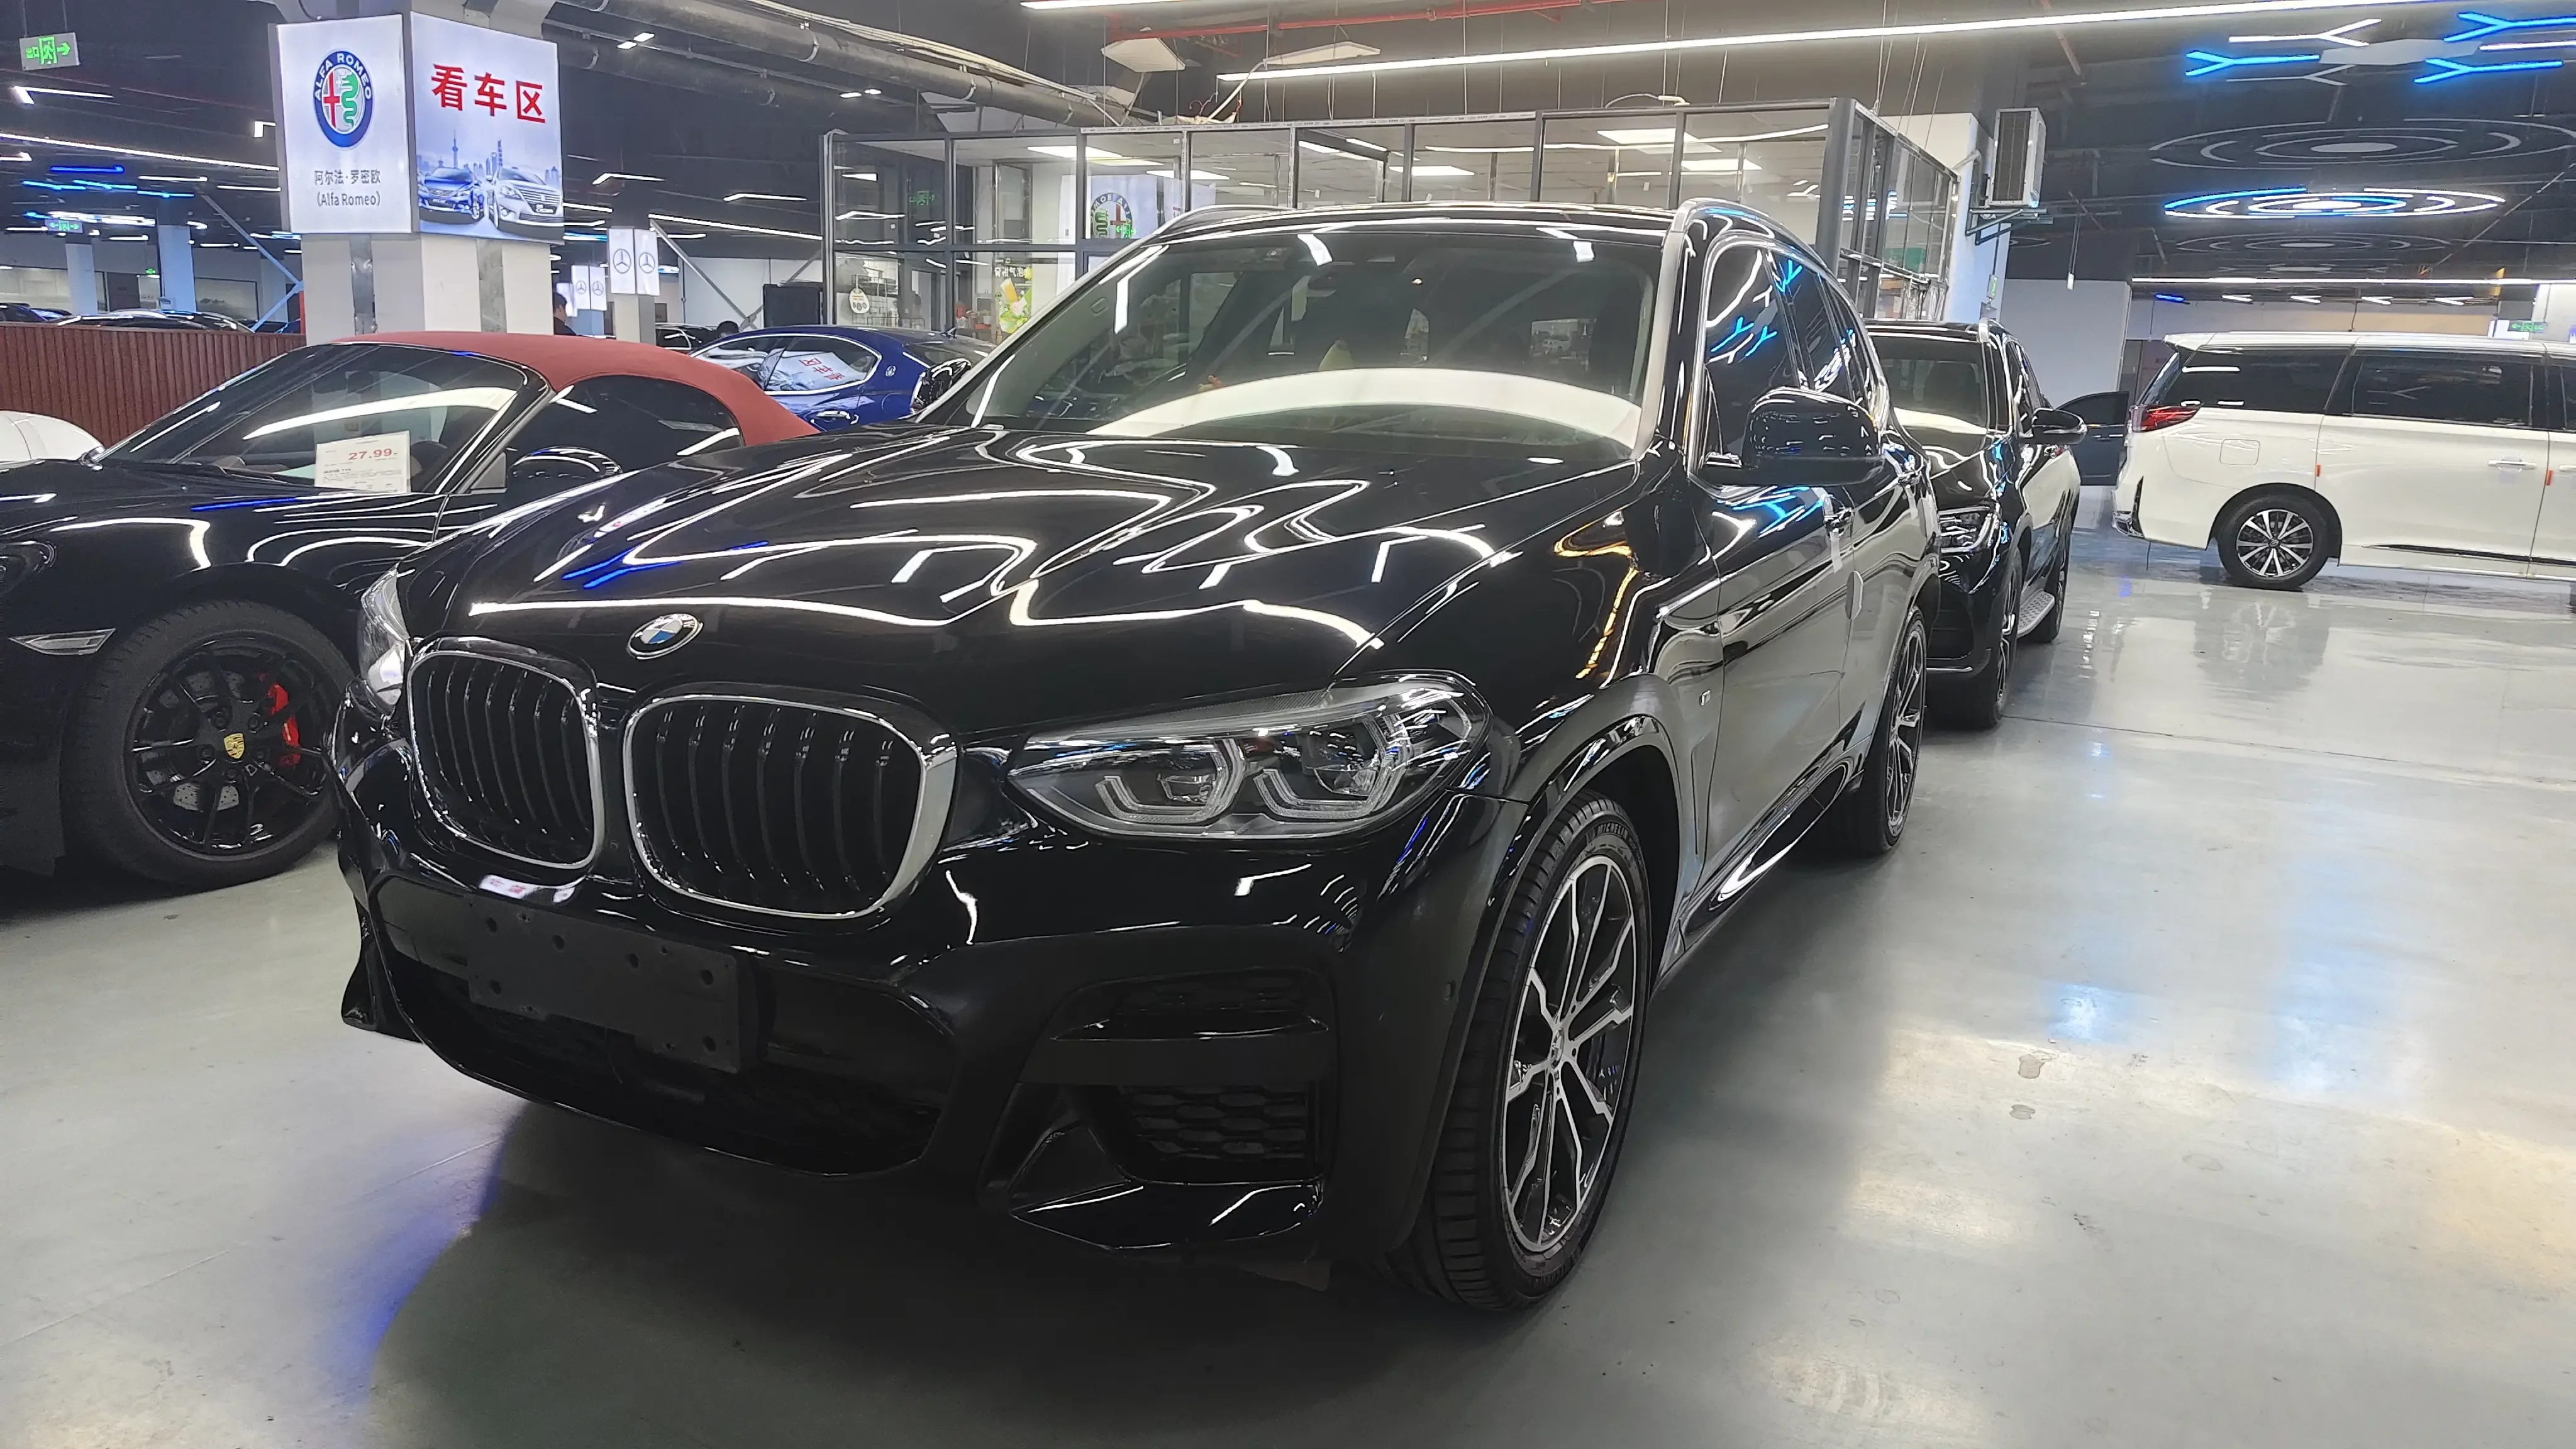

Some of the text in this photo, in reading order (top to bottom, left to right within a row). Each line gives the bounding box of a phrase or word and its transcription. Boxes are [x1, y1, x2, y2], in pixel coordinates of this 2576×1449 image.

[314, 52, 372, 101] ALFA ROMEO
[431, 64, 545, 124] 看车区
[314, 169, 380, 185] 阿尔法·罗密欧
[317, 190, 380, 207] (Alfa Romeo)
[348, 448, 392, 460] 27.99
[1597, 822, 1628, 840] MICHELIN
